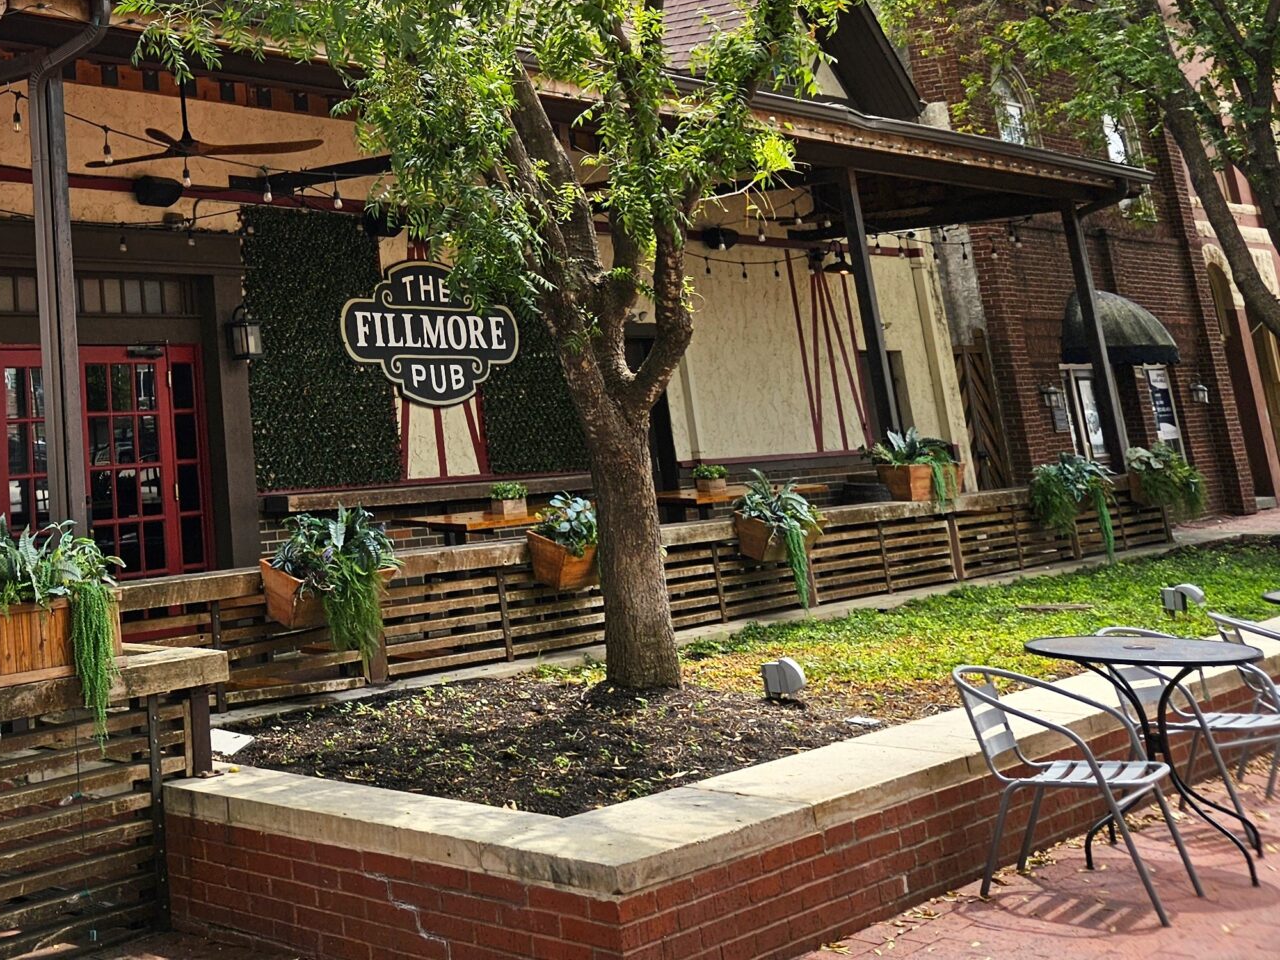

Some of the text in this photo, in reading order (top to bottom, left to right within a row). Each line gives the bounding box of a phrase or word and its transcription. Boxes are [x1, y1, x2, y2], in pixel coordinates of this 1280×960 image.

[401, 275, 452, 303] THE
[354, 311, 507, 350] FILLMORE
[411, 364, 465, 393] PUB
